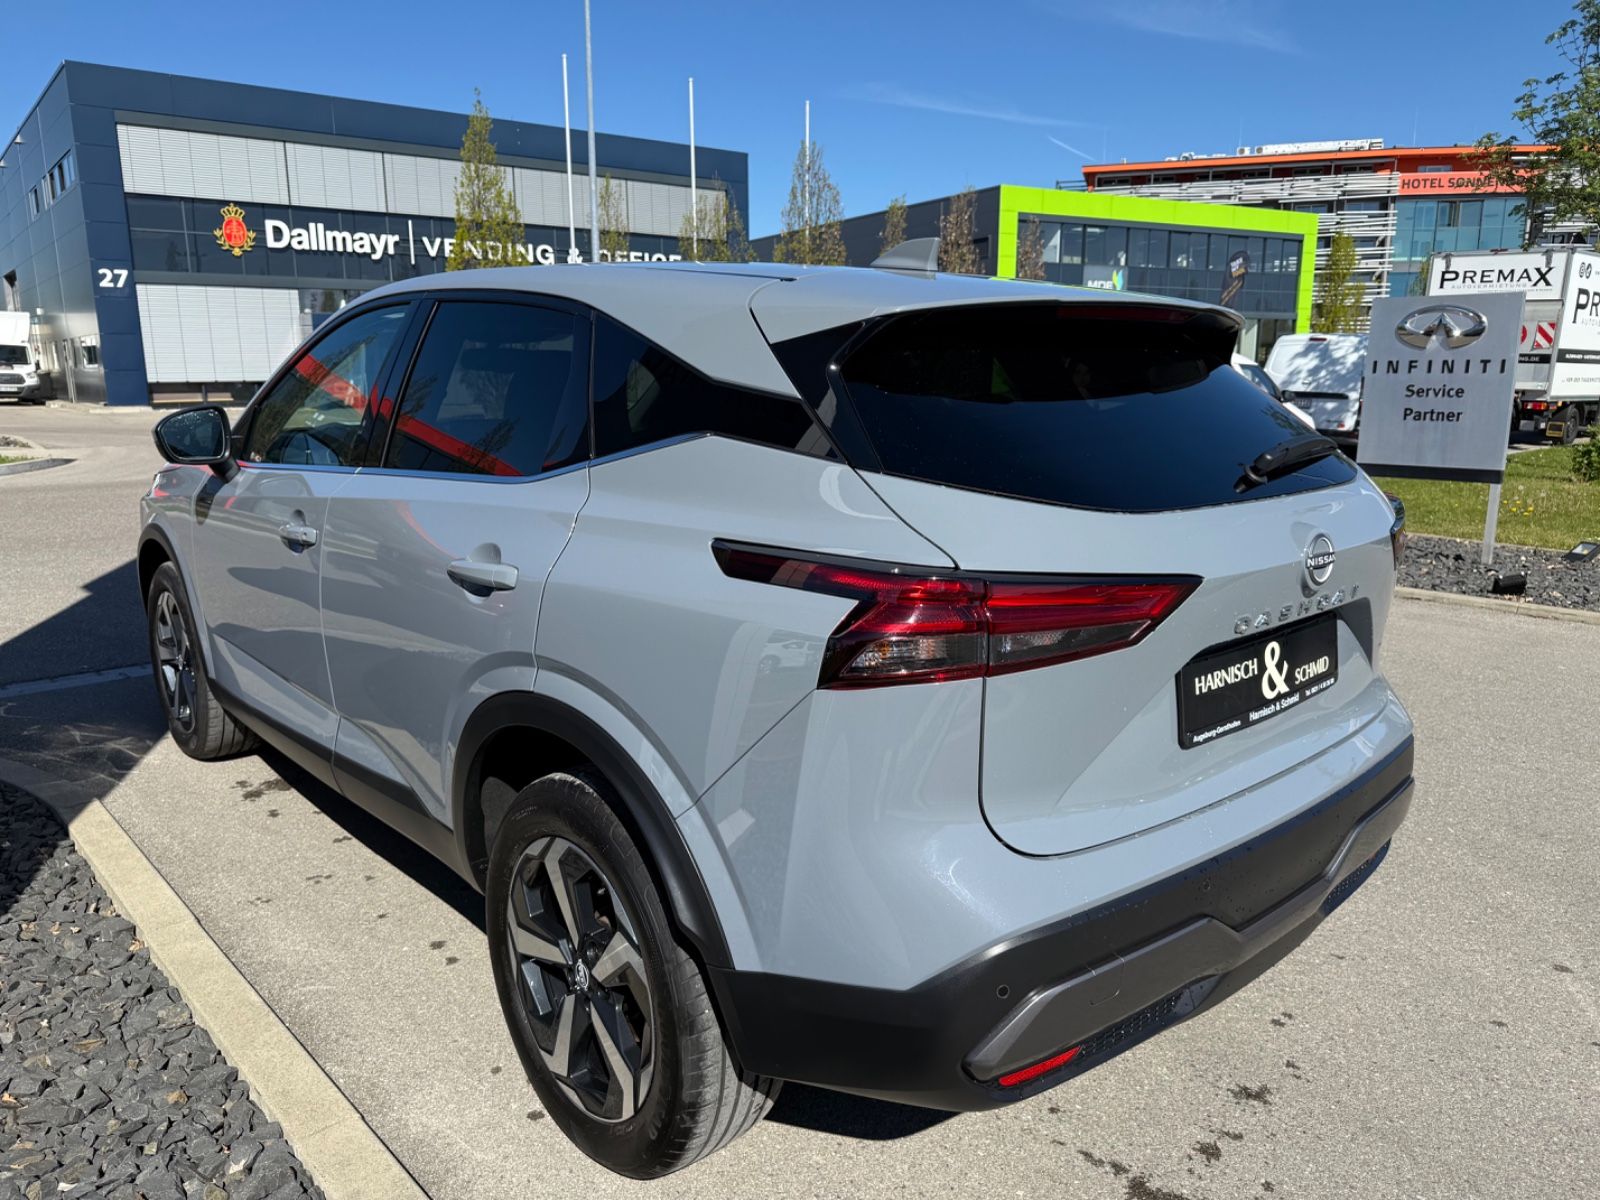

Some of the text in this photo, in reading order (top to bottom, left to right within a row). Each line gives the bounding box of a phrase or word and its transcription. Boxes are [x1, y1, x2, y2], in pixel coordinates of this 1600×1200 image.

[1401, 177, 1445, 190] HOTEL
[264, 218, 400, 260] Dallmayr
[421, 236, 555, 265] VENDING
[566, 248, 583, 264] &
[97, 268, 129, 288] 27
[1439, 266, 1556, 289] PREMAX
[1371, 359, 1507, 375] INFINITI
[1404, 384, 1465, 399] Service
[1402, 408, 1463, 422] Partner
[1194, 658, 1258, 696] HARNISCH
[1261, 640, 1290, 700] &
[1294, 656, 1330, 685] SCHMID
[1249, 703, 1275, 722] Harnisch
[1281, 692, 1300, 709] Schmid
